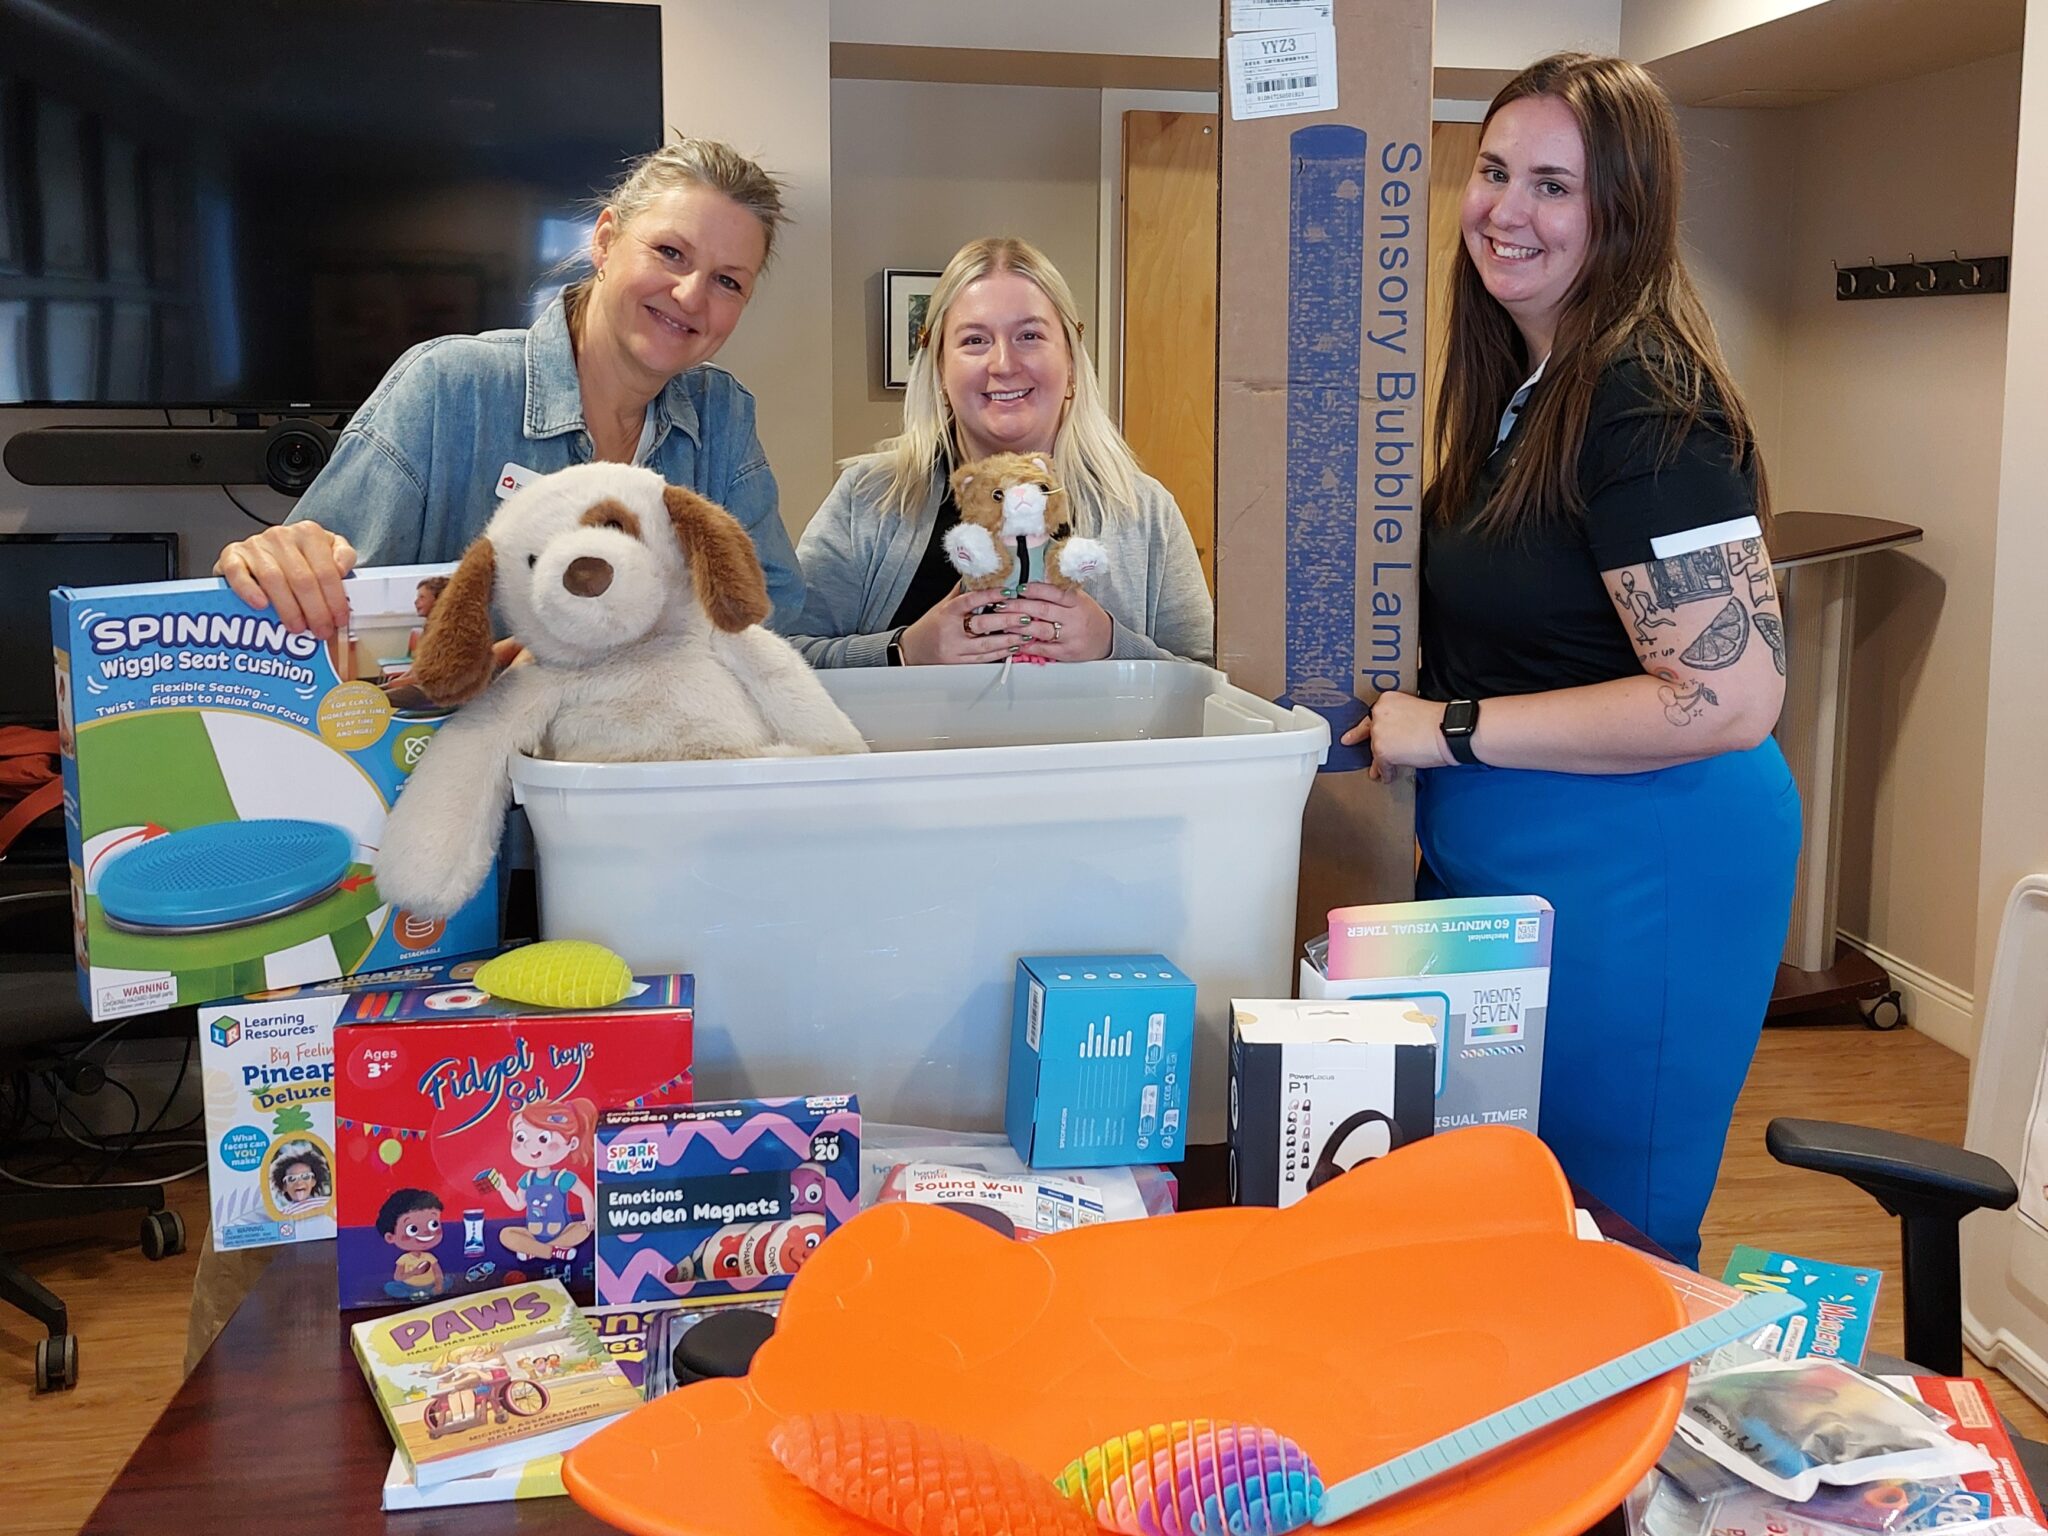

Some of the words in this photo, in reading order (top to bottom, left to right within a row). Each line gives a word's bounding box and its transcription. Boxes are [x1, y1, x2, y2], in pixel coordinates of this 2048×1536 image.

[1261, 38, 1297, 54] YYZ3
[1367, 142, 1421, 354] Sensory
[1373, 372, 1416, 544] Bubble
[93, 614, 318, 656] SPINNING
[1361, 562, 1412, 693] Lamp
[100, 652, 174, 679] Wiggle
[178, 650, 229, 670] Seat
[234, 654, 314, 685] Cushion
[152, 682, 205, 694] Flexible
[209, 682, 261, 698] Seating
[96, 700, 135, 717] Twist
[150, 695, 193, 706] Fidget
[199, 694, 212, 703] to
[216, 695, 250, 707] Relax
[252, 701, 275, 714] and
[277, 706, 310, 725] Focus
[1347, 924, 1389, 938] TIMER
[1391, 922, 1439, 935] VISUAL
[1441, 920, 1492, 933] MINUTE
[1494, 918, 1510, 929] 60
[1468, 933, 1509, 943] Mechanical
[122, 981, 169, 998] WARNING
[1473, 987, 1522, 1005] TWENTY5
[244, 1013, 304, 1028] Learning
[1472, 1003, 1520, 1025] SEVEN
[270, 1046, 291, 1066] Big
[296, 1042, 335, 1062] Feelin
[363, 1048, 398, 1062] Ages
[242, 1062, 335, 1086] Pineap
[367, 1062, 393, 1079] 3+
[416, 1036, 535, 1138] Fidget
[548, 1041, 595, 1106] toys
[506, 1076, 549, 1112] Set
[1289, 1081, 1308, 1094] P1
[258, 1086, 332, 1109] Deluxe
[606, 1110, 651, 1118] Emotions
[606, 1114, 669, 1124] Wooden
[673, 1108, 743, 1121] Magnets
[1435, 1111, 1478, 1128] ISUAL
[1481, 1108, 1528, 1124] TIMER
[224, 1142, 248, 1151] faces
[232, 1134, 257, 1143] What
[814, 1137, 828, 1145] Set
[830, 1135, 839, 1144] of
[234, 1149, 257, 1158] YOU
[814, 1143, 840, 1161] 20
[231, 1156, 261, 1166] make?
[608, 1189, 684, 1206] Emotions
[608, 1207, 687, 1227] Wooden
[693, 1198, 780, 1224] Magnets
[743, 1236, 755, 1276] ASHAMED
[768, 1246, 779, 1275] CONFU
[389, 1291, 551, 1351] PAWS
[407, 1345, 440, 1356] HAZEL
[444, 1338, 465, 1347] HAS
[468, 1332, 489, 1341] HER
[492, 1323, 527, 1335] HANDS
[530, 1318, 553, 1326] FULL
[604, 1339, 640, 1353] et
[487, 1426, 531, 1441] NATHAN
